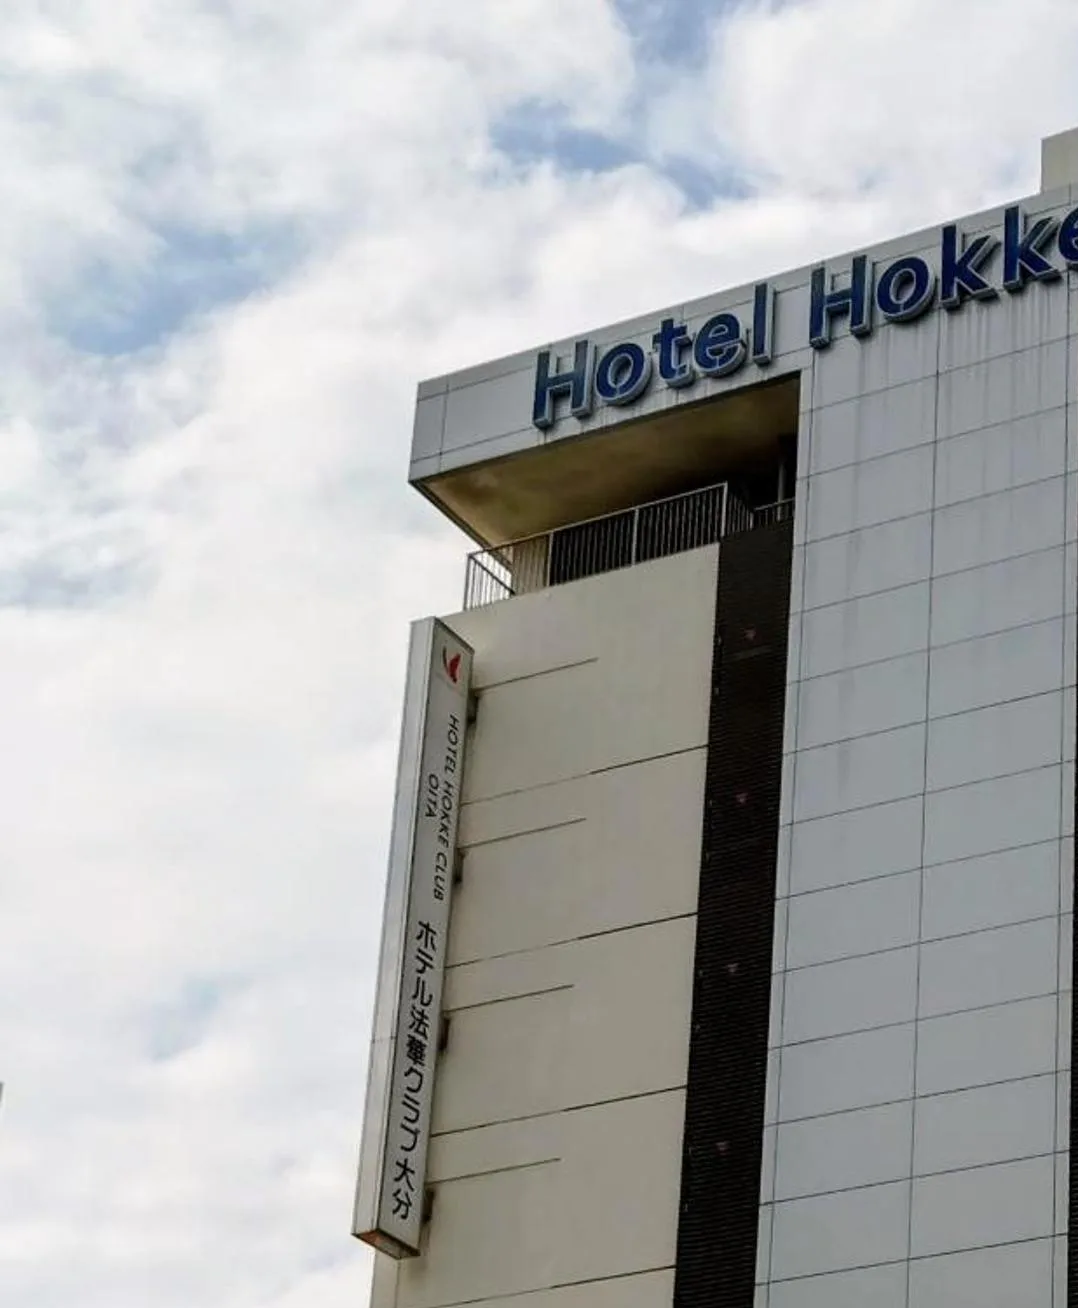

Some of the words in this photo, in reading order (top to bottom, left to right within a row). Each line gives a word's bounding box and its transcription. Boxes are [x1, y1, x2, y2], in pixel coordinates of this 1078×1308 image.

[532, 283, 776, 430] Hotel
[444, 713, 460, 774] HOTEL
[425, 773, 440, 819] OITA
[437, 780, 453, 849] HOKKE
[433, 852, 448, 901] CLUB
